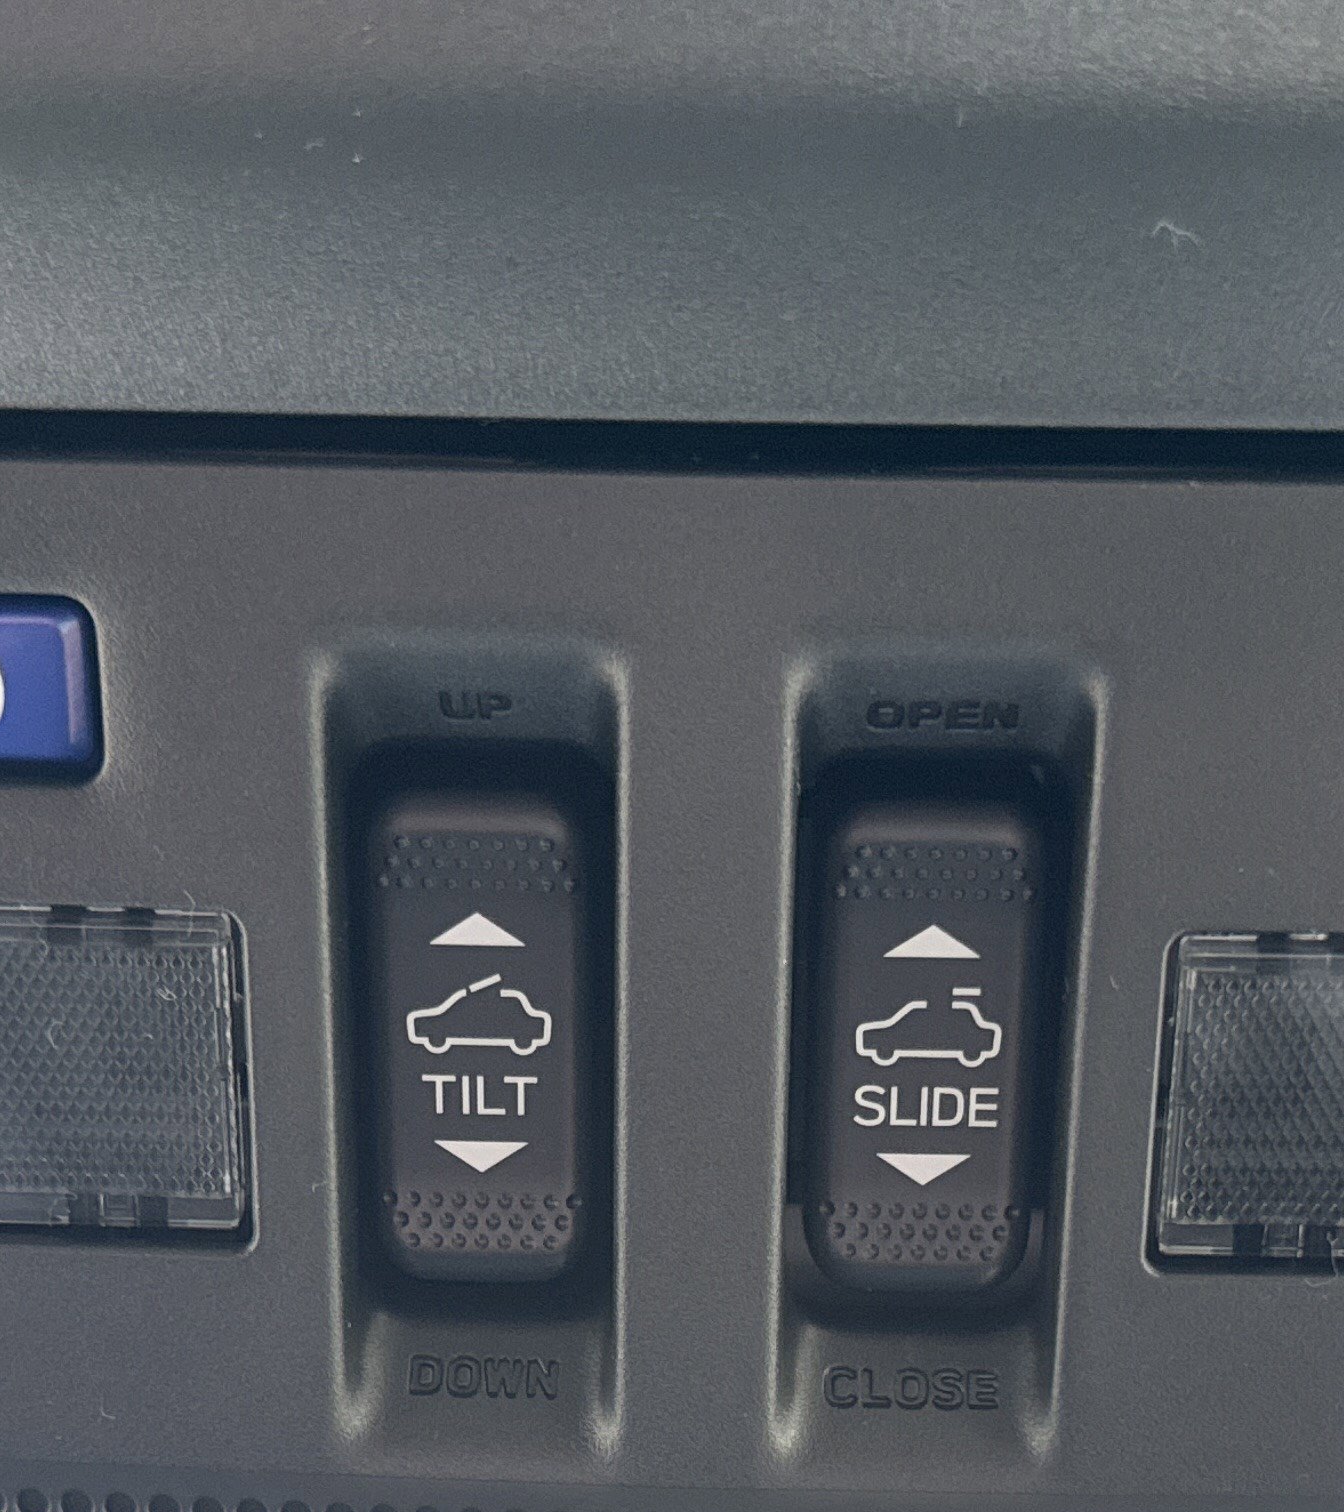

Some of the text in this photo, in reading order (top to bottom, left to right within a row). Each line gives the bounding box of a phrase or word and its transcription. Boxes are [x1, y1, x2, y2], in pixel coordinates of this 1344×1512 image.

[438, 690, 513, 721] UP
[866, 700, 1020, 731] OPEN
[422, 1073, 539, 1117] TILT
[854, 1085, 1000, 1130] SLIDE
[409, 1355, 559, 1399] DOWN
[824, 1366, 1000, 1411] CLOSE
